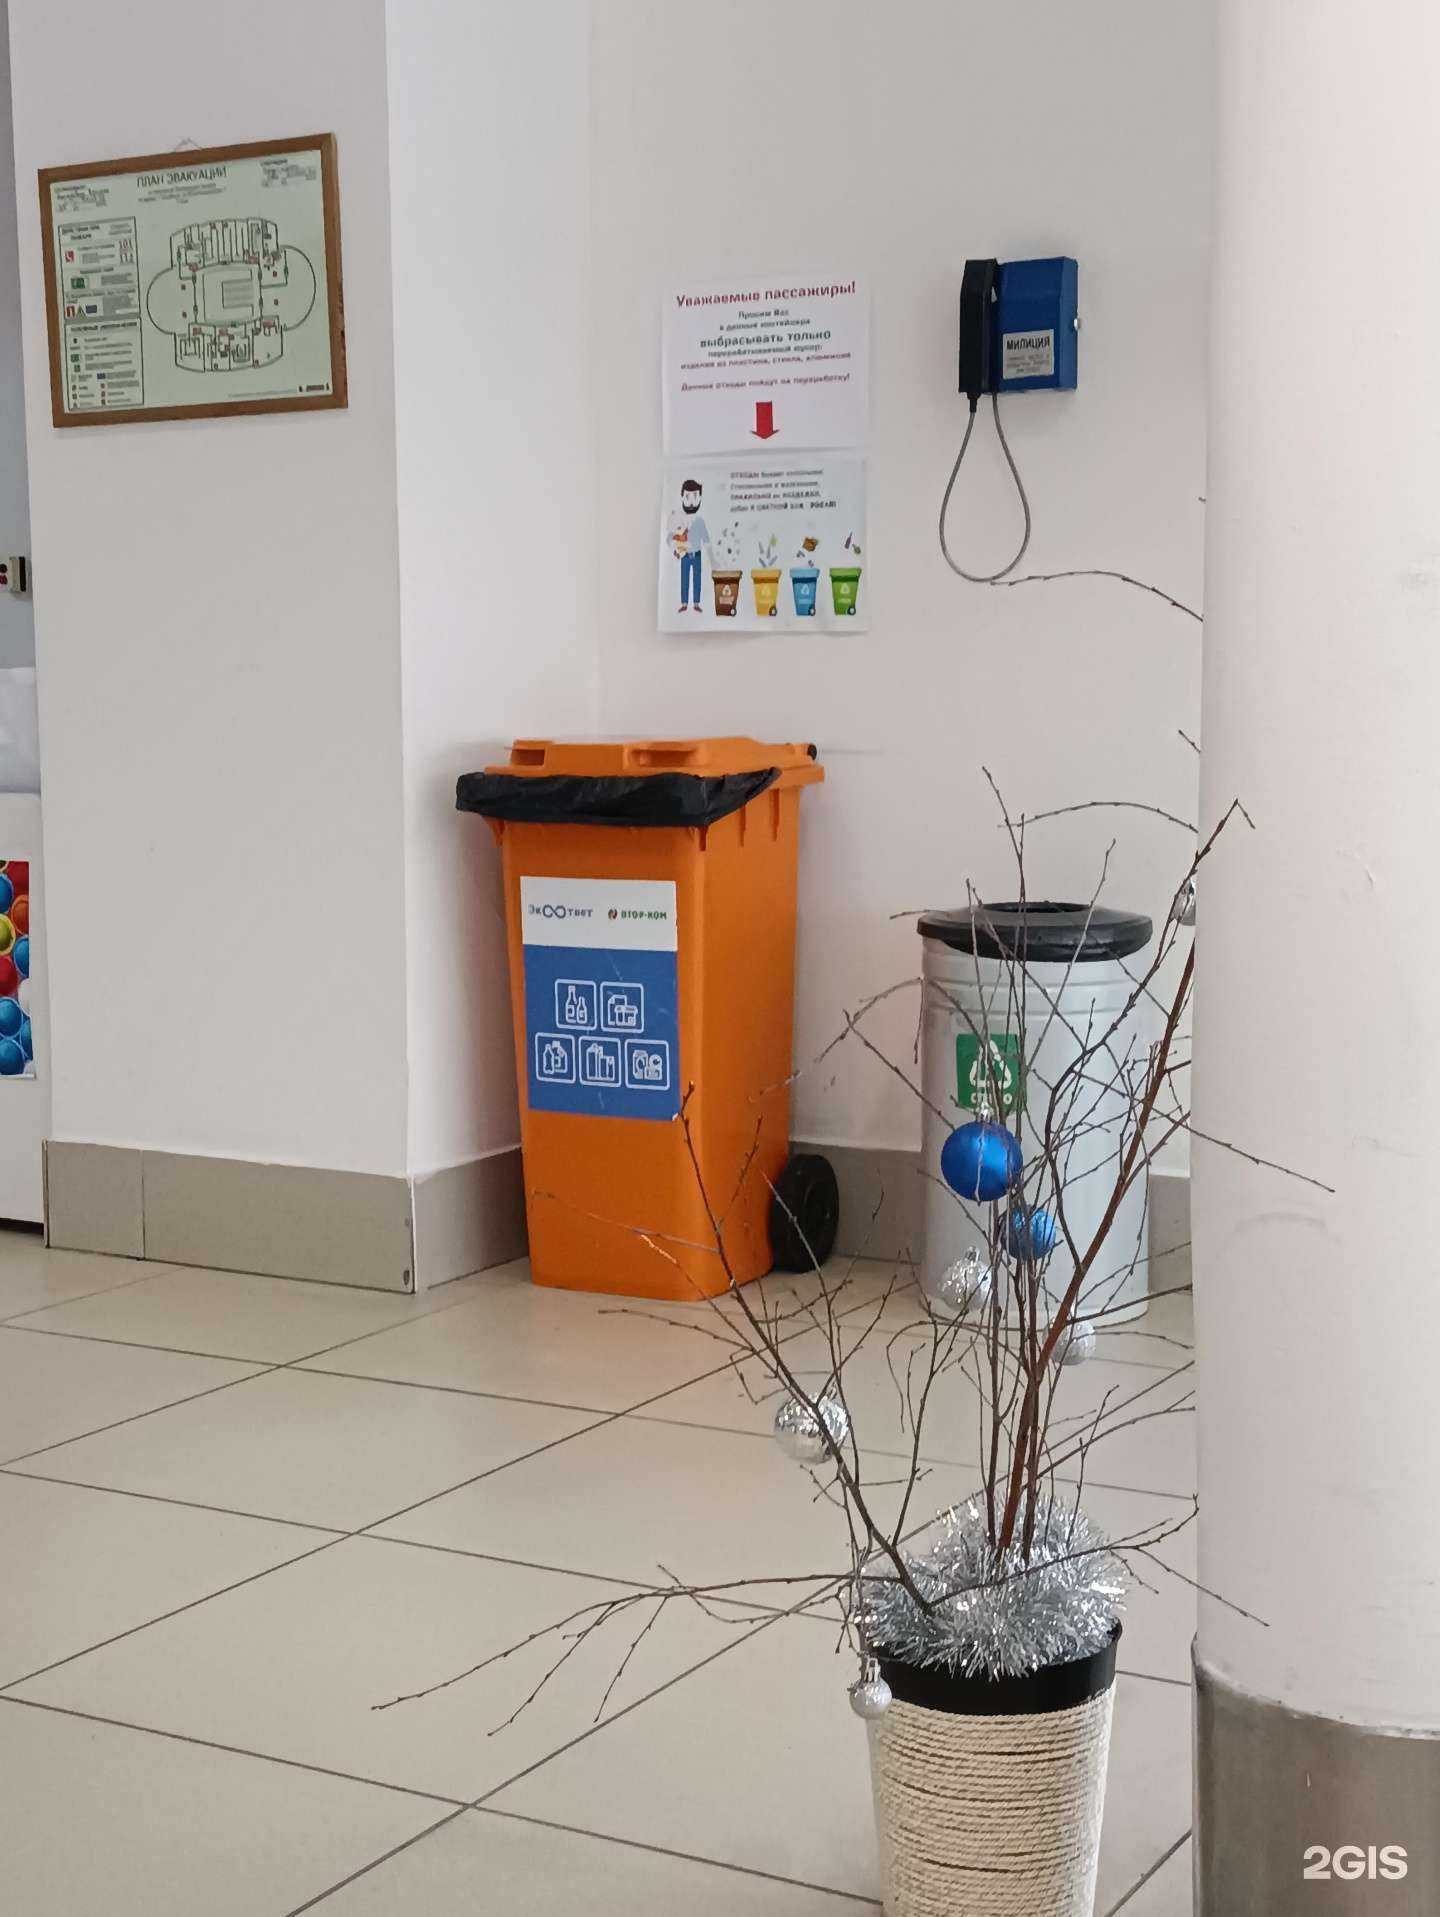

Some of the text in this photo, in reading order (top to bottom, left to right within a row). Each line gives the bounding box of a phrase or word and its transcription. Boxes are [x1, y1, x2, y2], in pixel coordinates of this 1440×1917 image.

[136, 165, 228, 189] ПЛАН ЭВАКУАЦИИ
[676, 281, 857, 308] Уважаемые пассажиры!
[700, 329, 831, 348] выбрасывать только
[1006, 336, 1050, 351] МИЛИЦИЯ
[620, 908, 668, 921] ВТОР-КОМ
